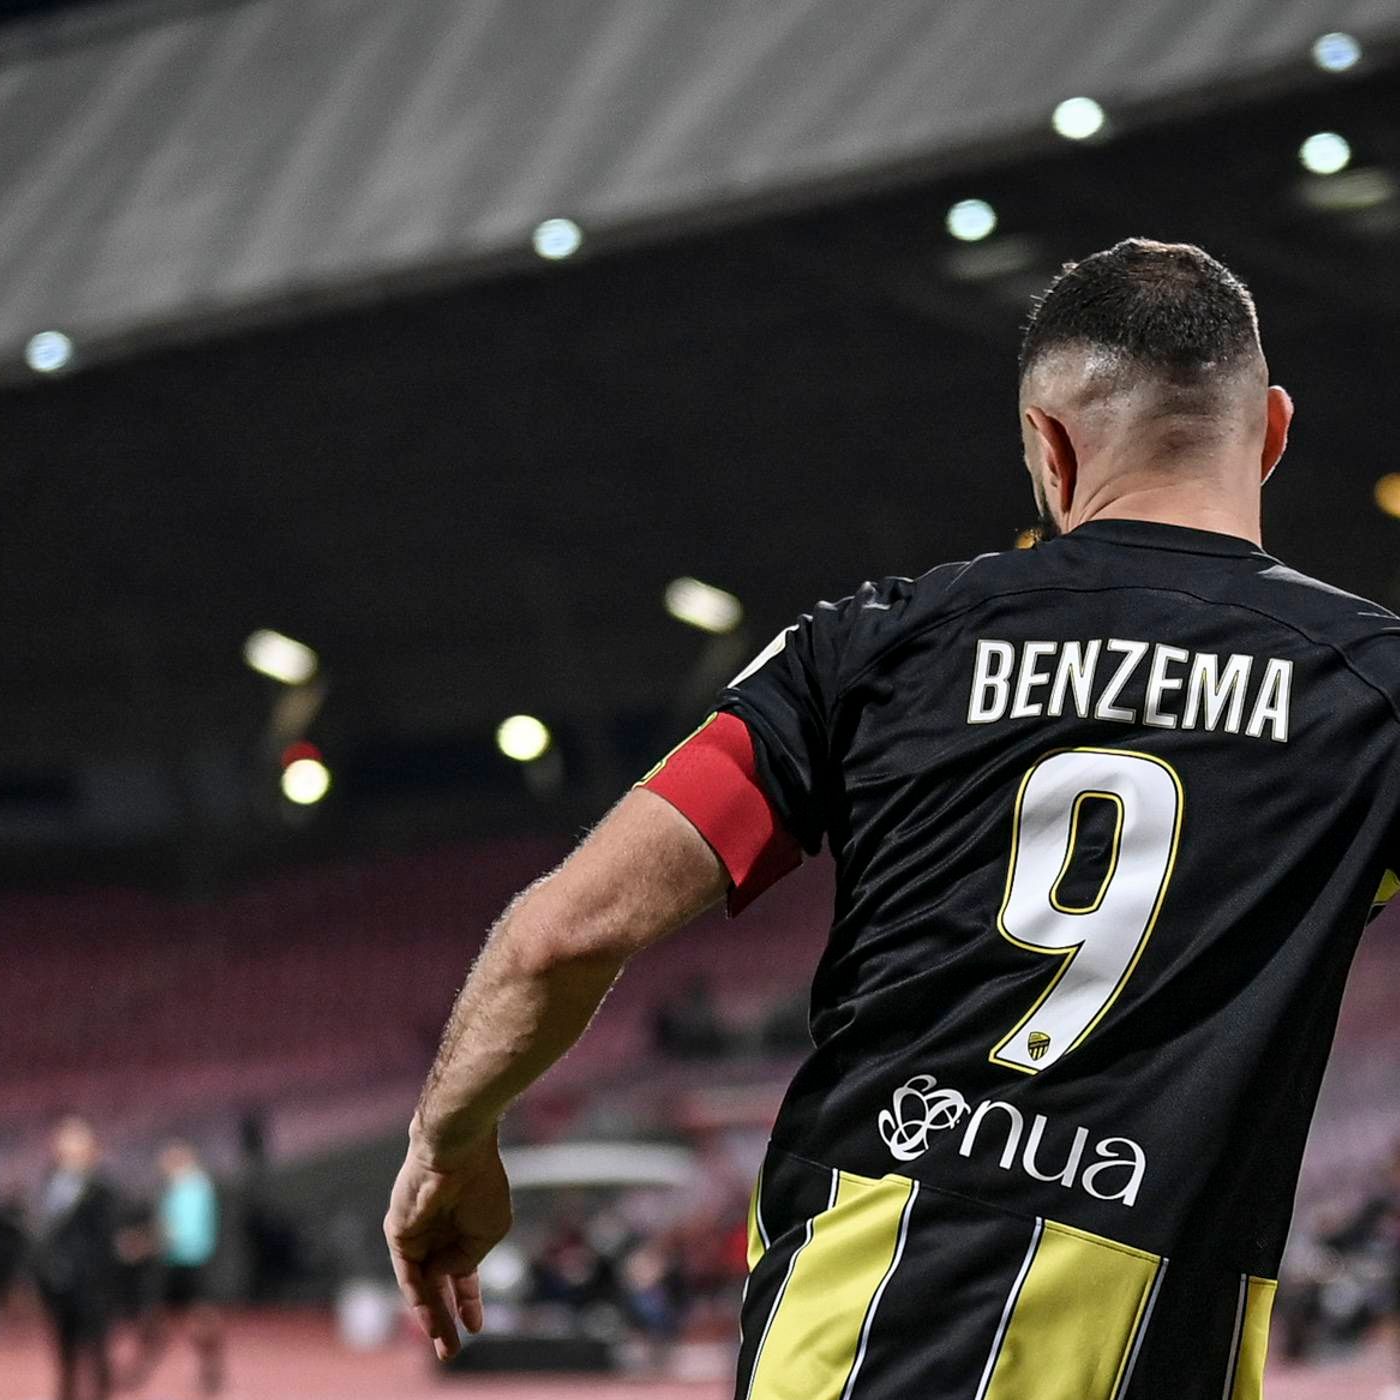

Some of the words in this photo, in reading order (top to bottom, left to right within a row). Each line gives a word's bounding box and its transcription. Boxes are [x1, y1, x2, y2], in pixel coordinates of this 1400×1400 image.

[967, 639, 1294, 742] BENZEMA
[988, 746, 1184, 1076] 9
[959, 1100, 1146, 1207] nua
